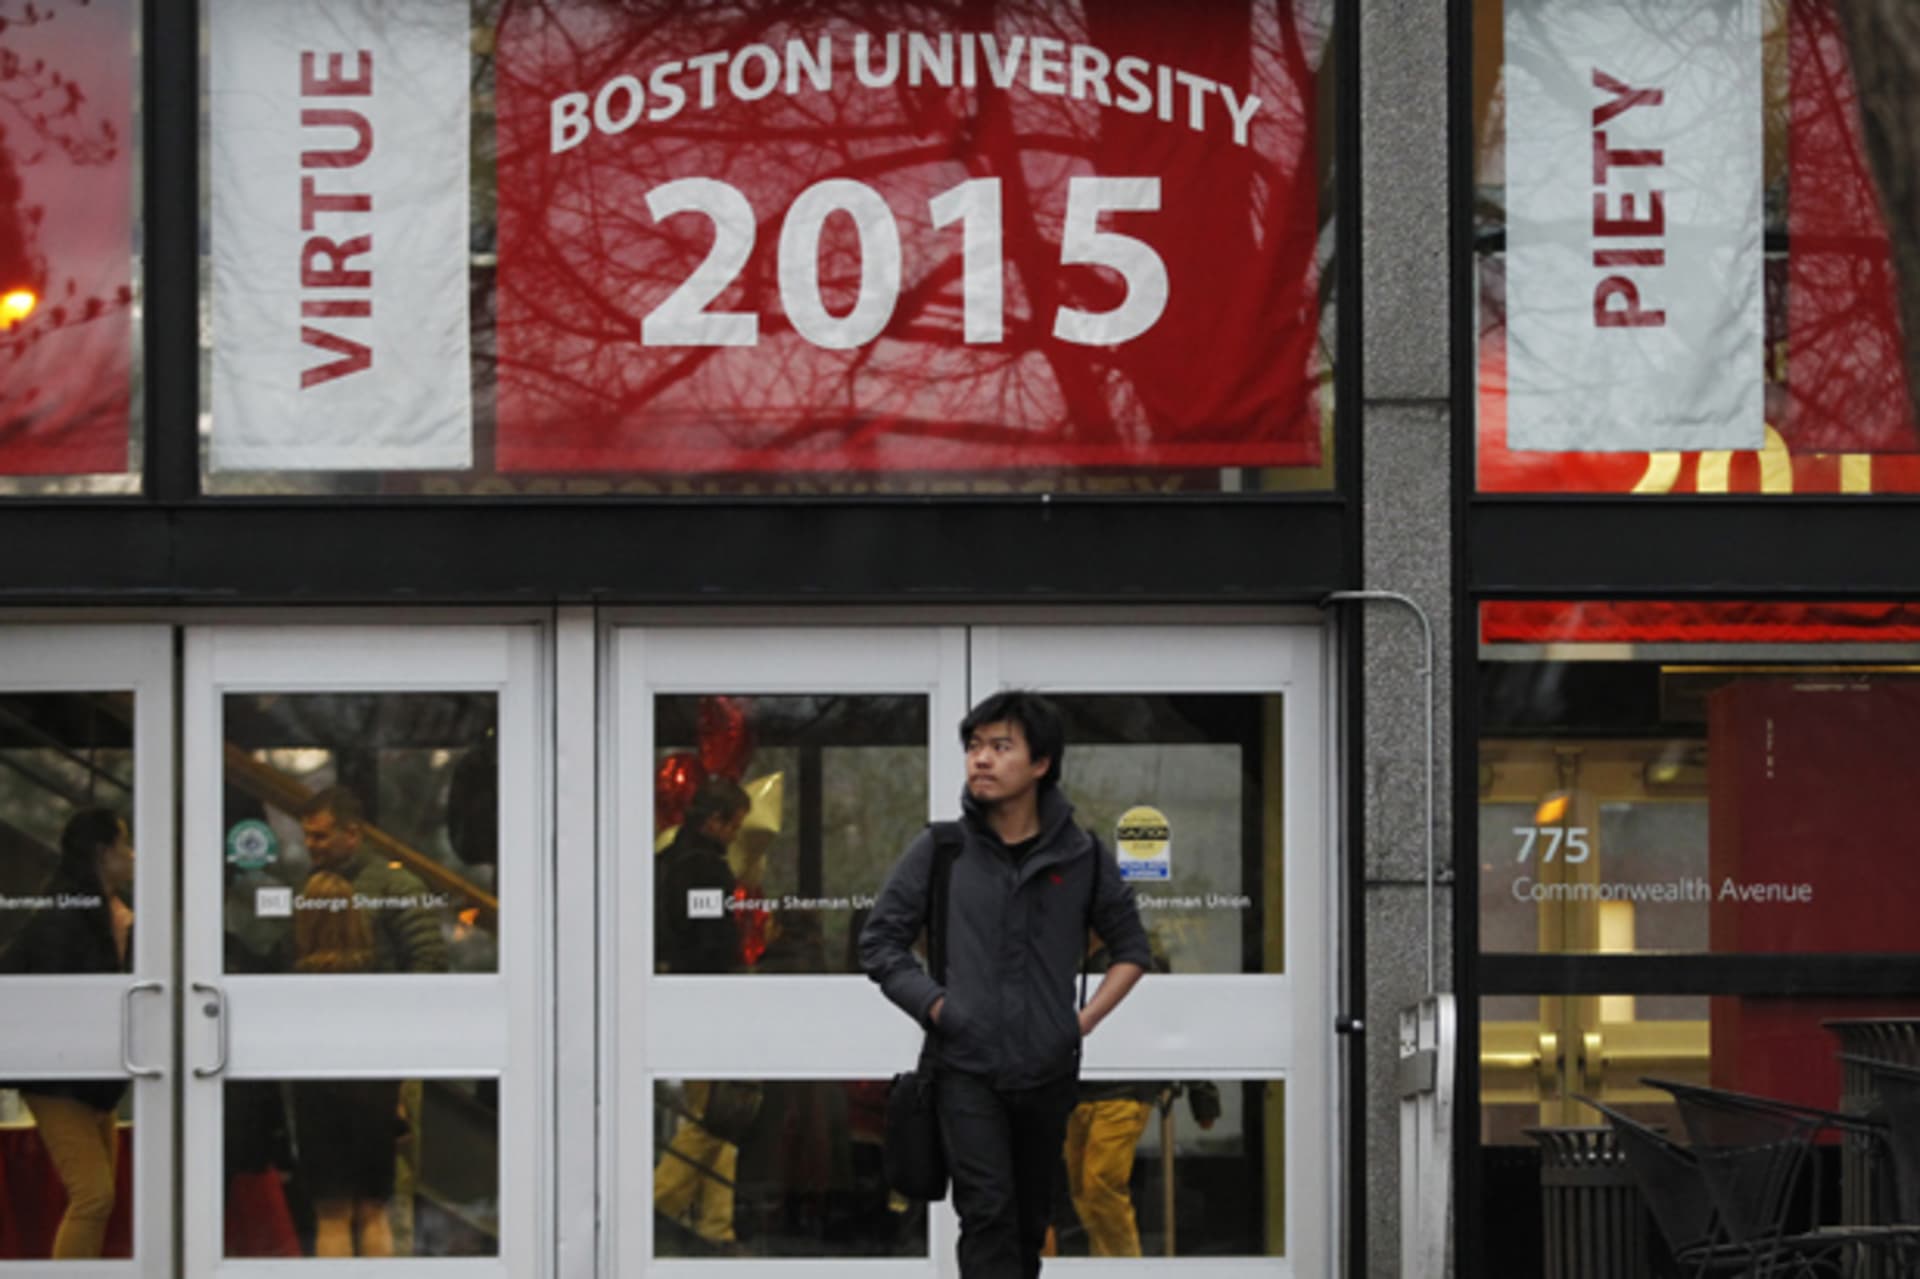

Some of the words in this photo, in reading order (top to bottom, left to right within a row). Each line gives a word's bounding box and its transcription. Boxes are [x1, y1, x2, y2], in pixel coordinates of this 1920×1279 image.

[551, 36, 832, 154] BOSTON
[853, 33, 1262, 146] UNIVERSITY
[1593, 69, 1665, 328] PIETY
[302, 51, 373, 388] VIRTUE
[641, 176, 1169, 350] 2015
[1511, 826, 1591, 864] 775
[57, 893, 101, 909] Union
[295, 894, 348, 912] George
[352, 893, 418, 909] Sherman
[725, 896, 779, 912] George
[784, 895, 849, 910] Sherman
[1135, 893, 1202, 909] Sherman
[1206, 892, 1251, 909] Union
[1511, 876, 1710, 901] Commonwealth
[1718, 876, 1813, 901] Avenue
